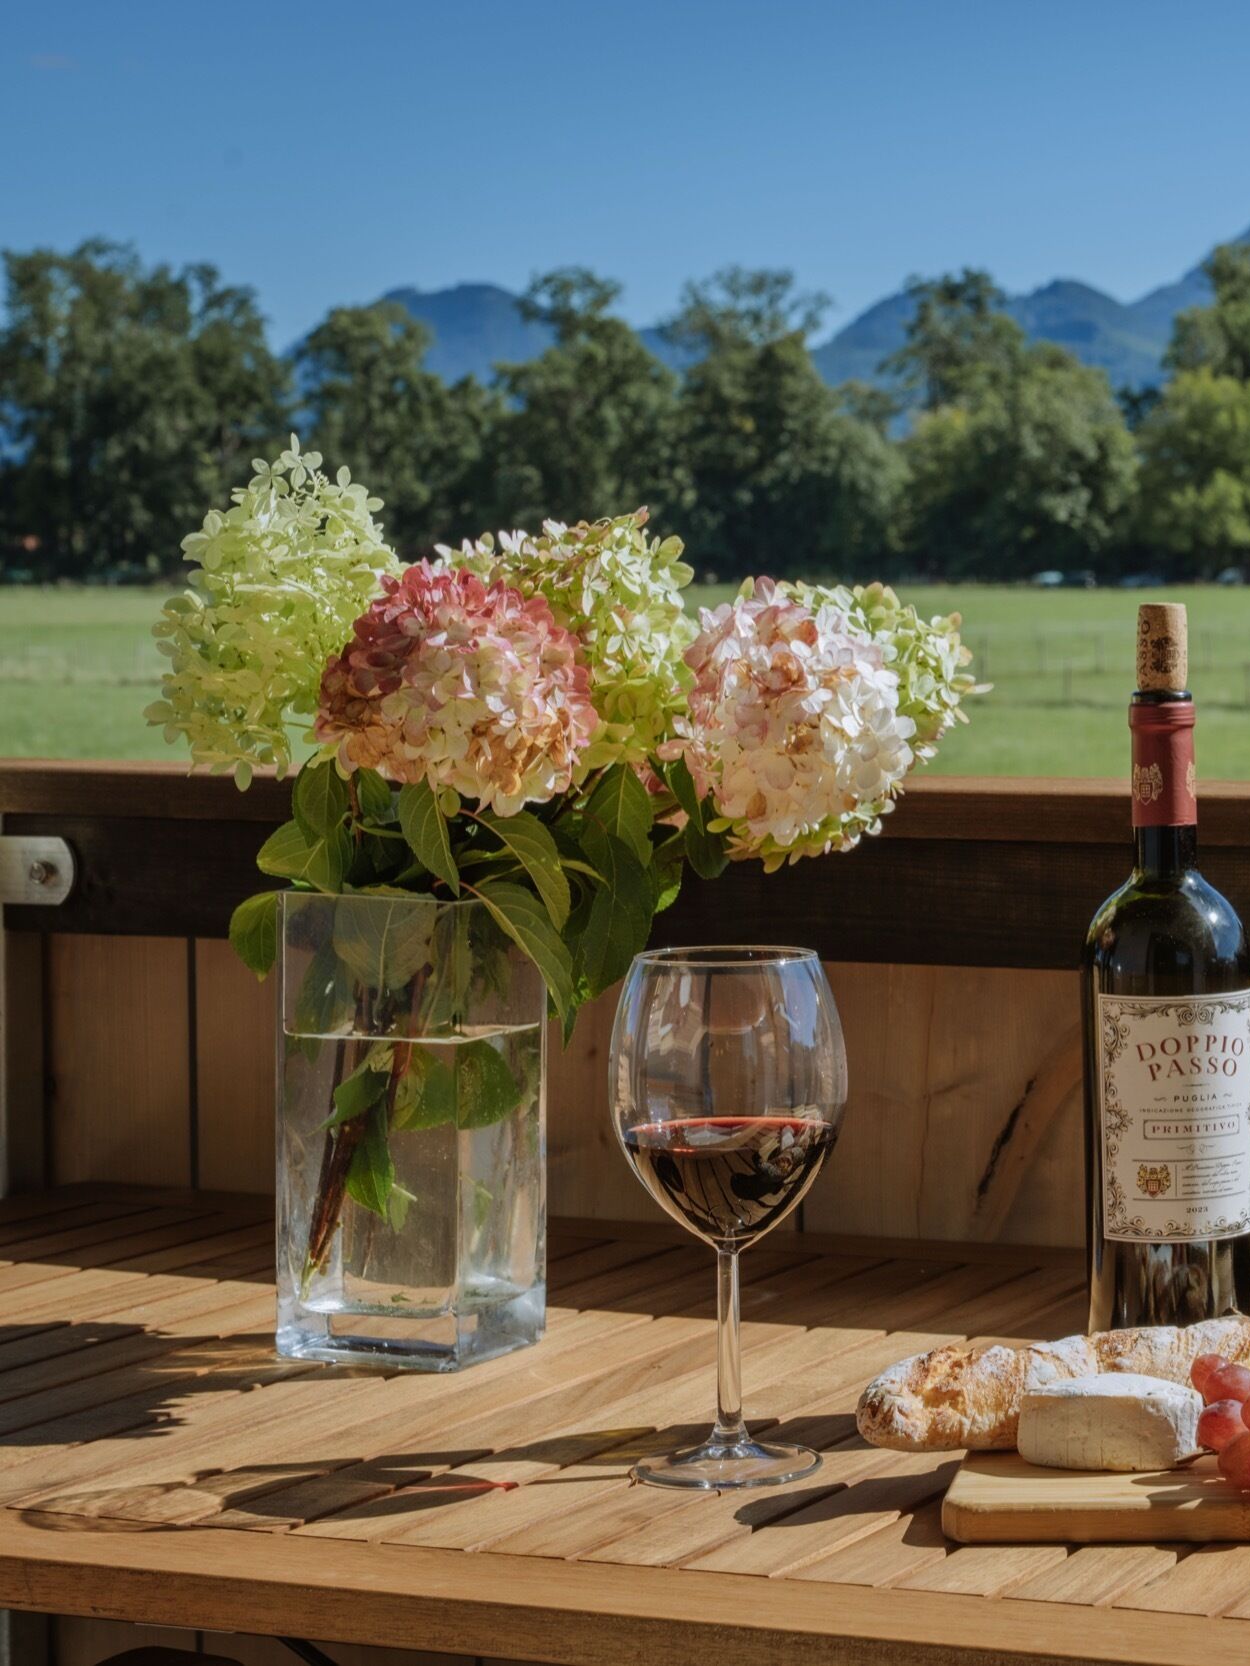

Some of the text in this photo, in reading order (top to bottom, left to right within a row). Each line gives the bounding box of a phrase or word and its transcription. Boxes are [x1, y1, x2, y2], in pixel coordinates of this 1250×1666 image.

[1135, 1034, 1244, 1062] DOPPIO
[1148, 1056, 1238, 1081] PASSO
[1173, 1093, 1217, 1103] PUGLIA
[1151, 1121, 1236, 1134] PRIMITIVO
